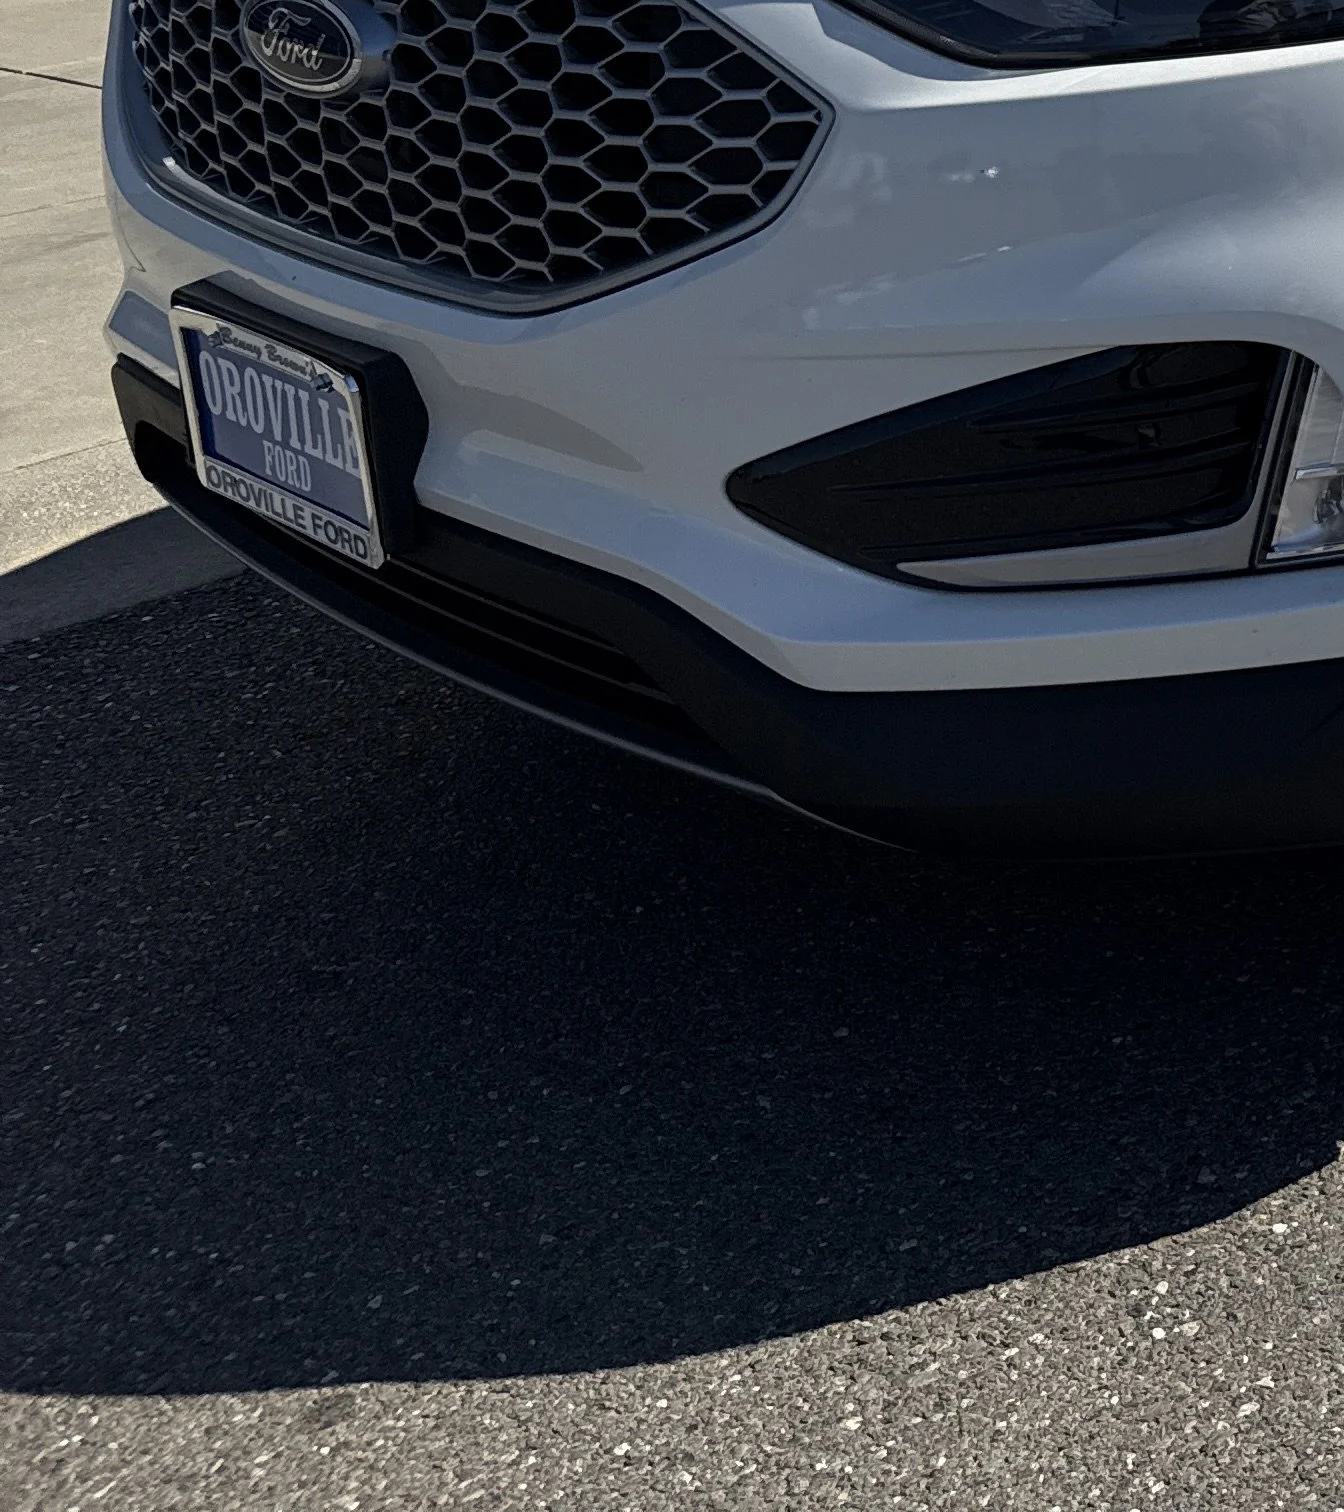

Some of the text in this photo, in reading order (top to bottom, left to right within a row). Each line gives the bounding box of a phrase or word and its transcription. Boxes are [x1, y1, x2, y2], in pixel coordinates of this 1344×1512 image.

[261, 7, 326, 71] Ford
[199, 350, 361, 478] OROVILLE
[262, 439, 312, 493] FORD
[206, 463, 368, 561] OROVILLE FORD
